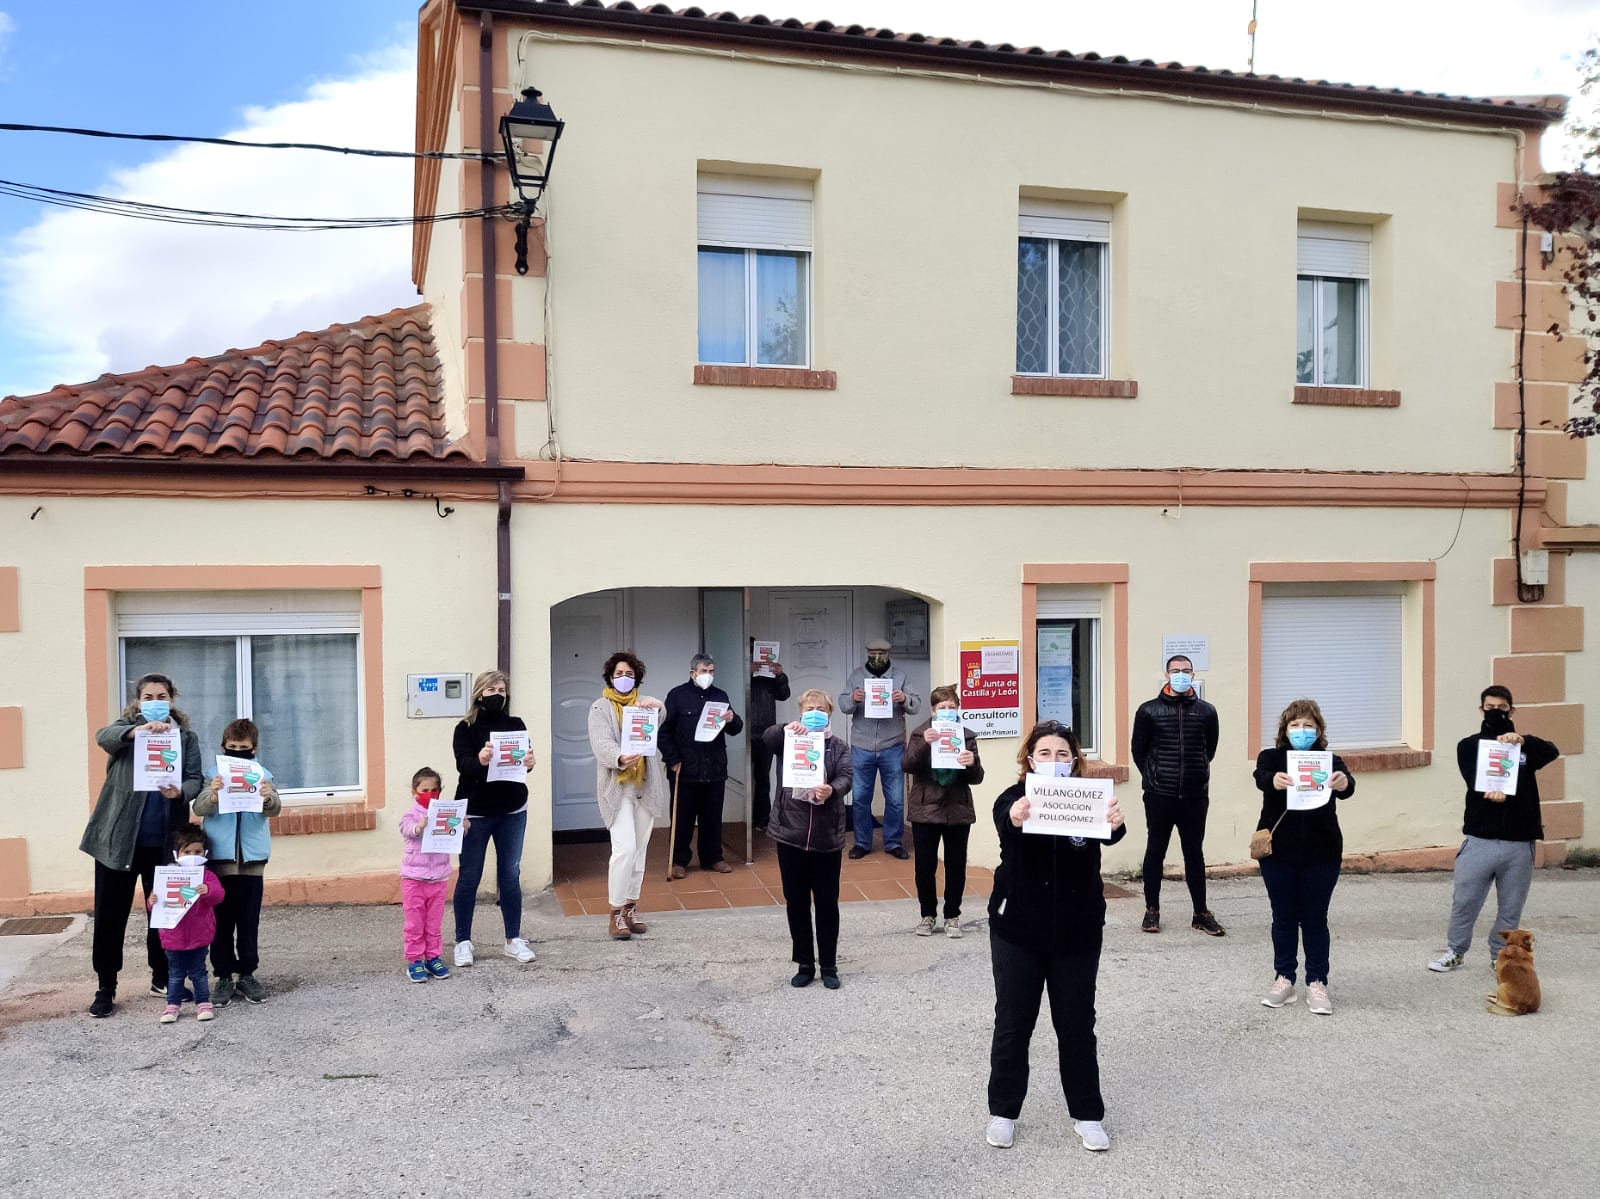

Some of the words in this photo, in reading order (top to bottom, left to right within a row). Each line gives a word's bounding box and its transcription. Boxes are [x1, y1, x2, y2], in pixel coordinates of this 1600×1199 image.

[982, 680, 1005, 688] Junta
[1006, 679, 1017, 687] de
[962, 689, 990, 697] Castilla
[991, 690, 996, 698] y
[998, 687, 1018, 696] León
[962, 710, 1018, 720] Consultorio
[1033, 787, 1103, 800] VILLANGÓMEZ
[1042, 801, 1092, 811] ASOCIACION
[1039, 813, 1094, 823] POLLOGÓMEZ
